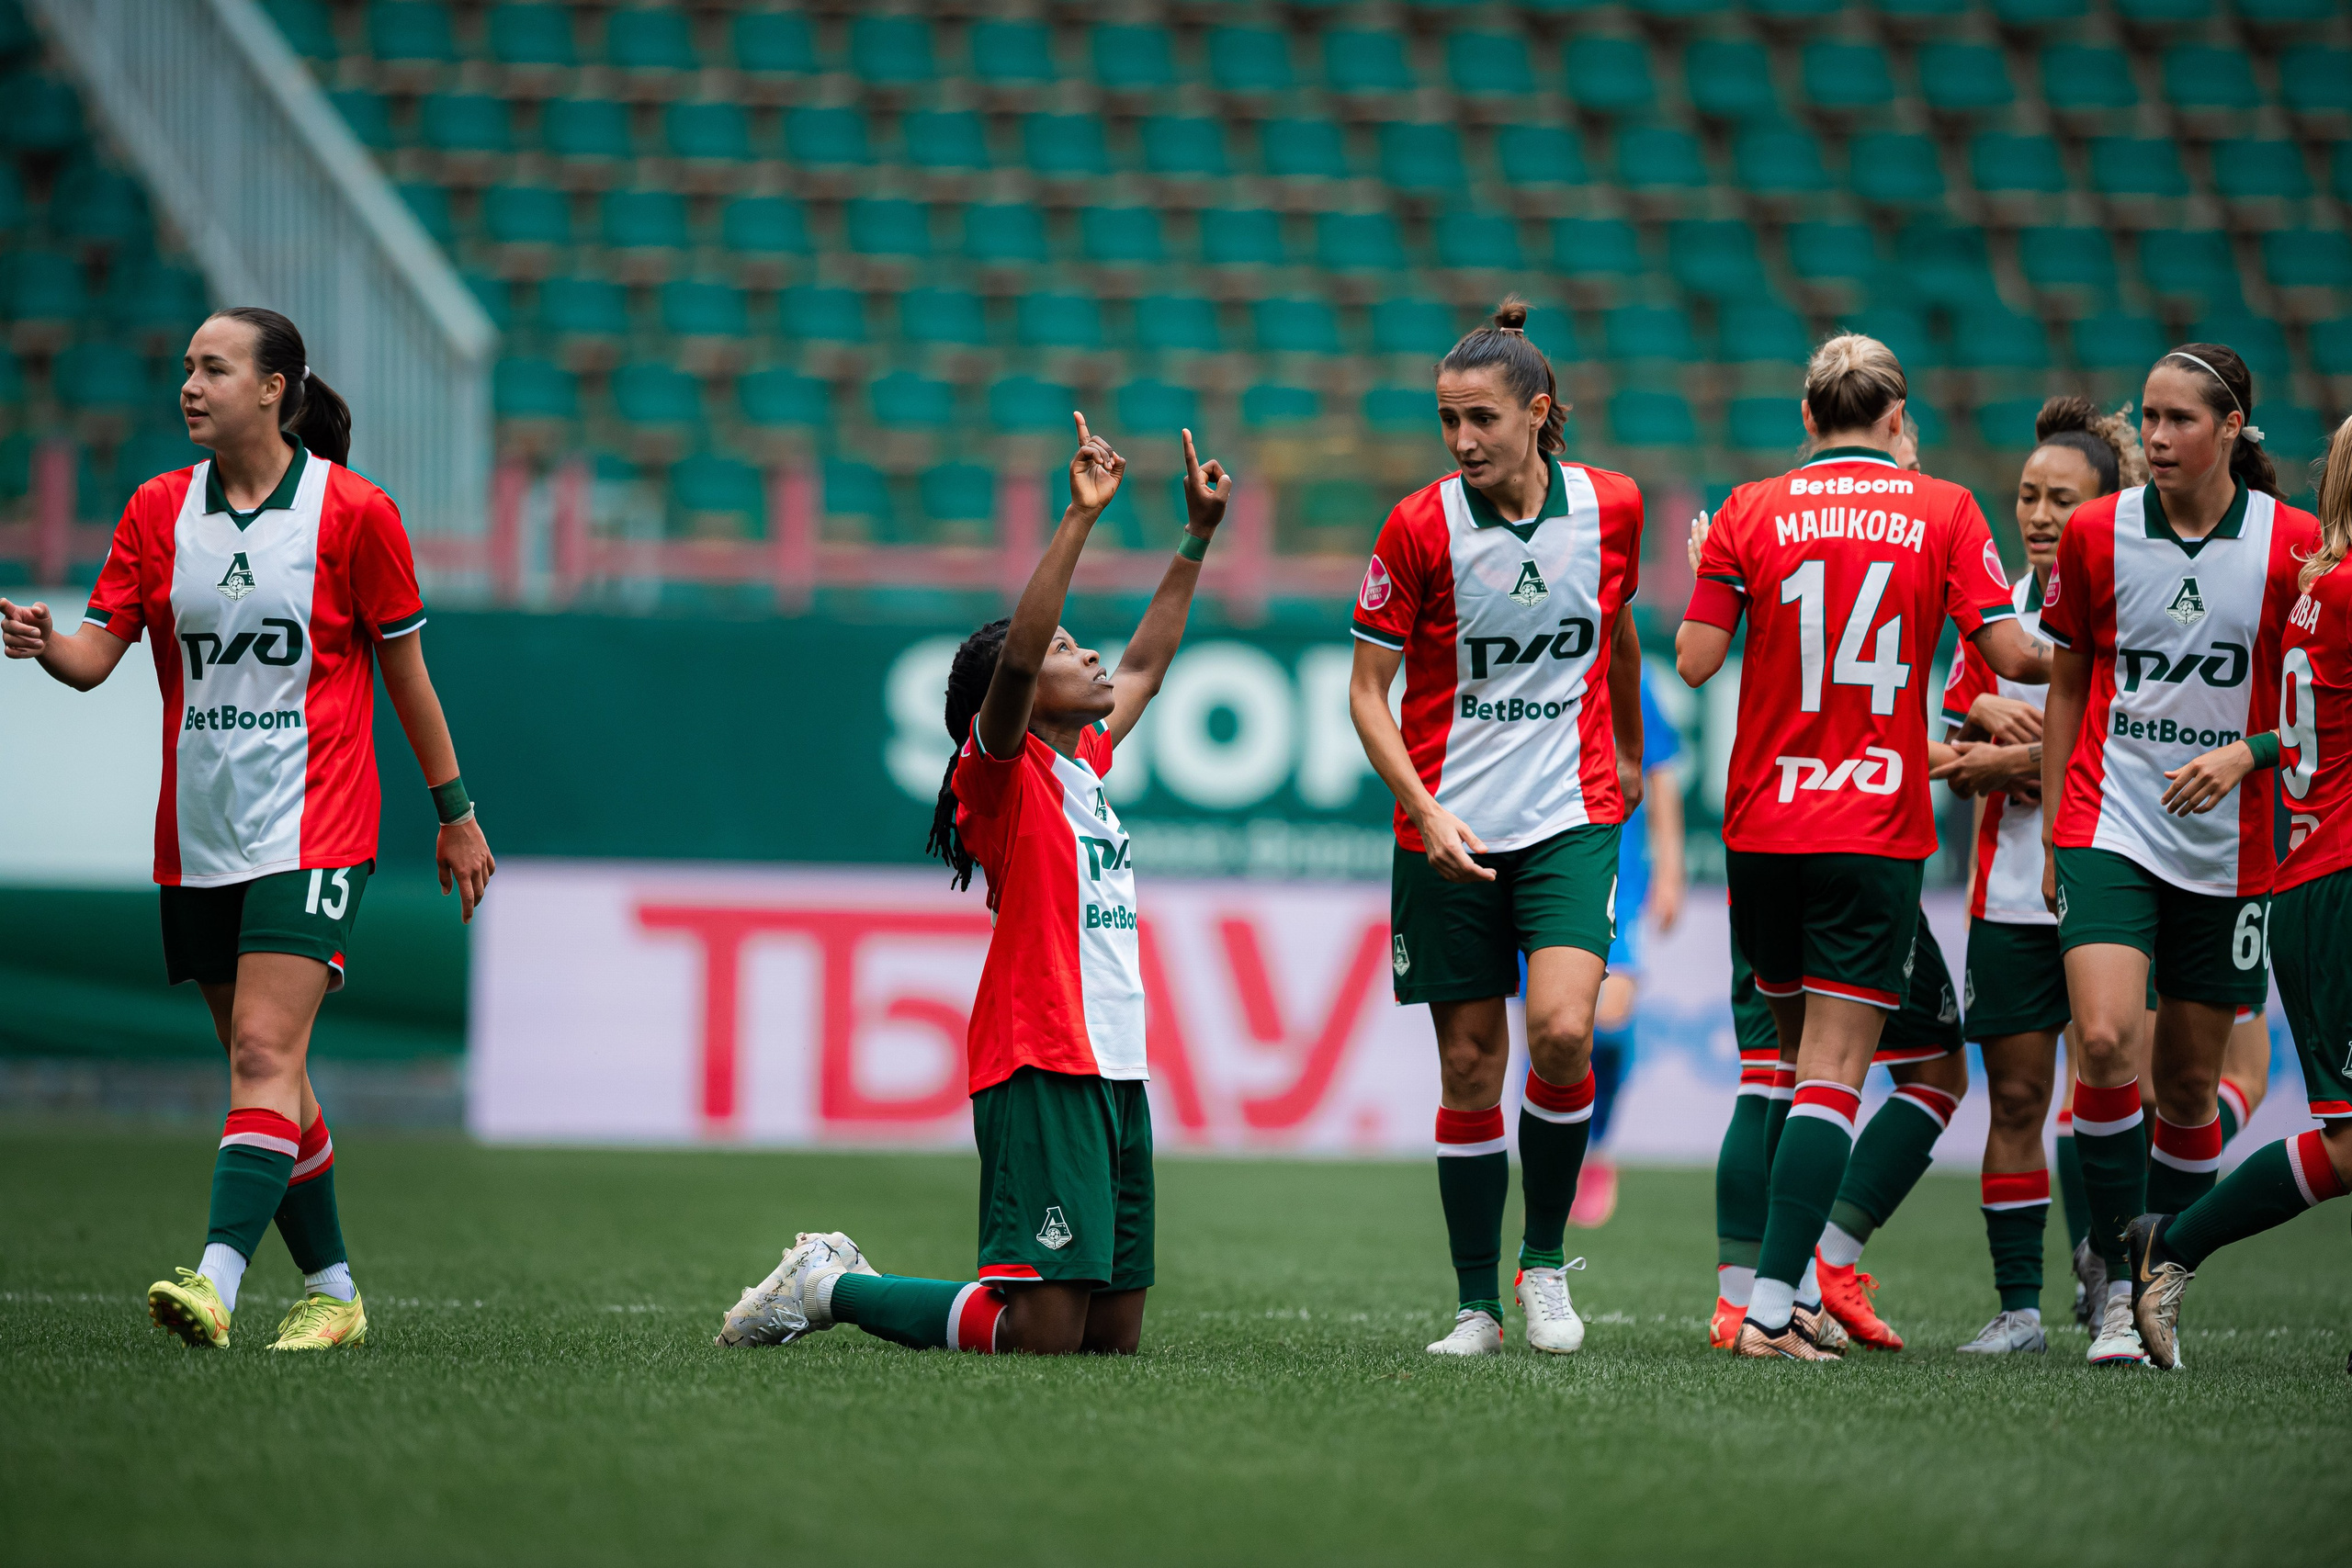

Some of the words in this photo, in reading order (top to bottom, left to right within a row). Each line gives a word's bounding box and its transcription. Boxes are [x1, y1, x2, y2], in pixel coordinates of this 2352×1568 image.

[1790, 477, 1914, 495] BetBoom
[1775, 506, 1926, 554] МАШКОВА
[2288, 594, 2322, 635] ОВА
[1781, 559, 1912, 716] 14
[185, 705, 301, 730] BetBoom
[2113, 711, 2241, 748] BetBoom
[305, 866, 351, 919] 13
